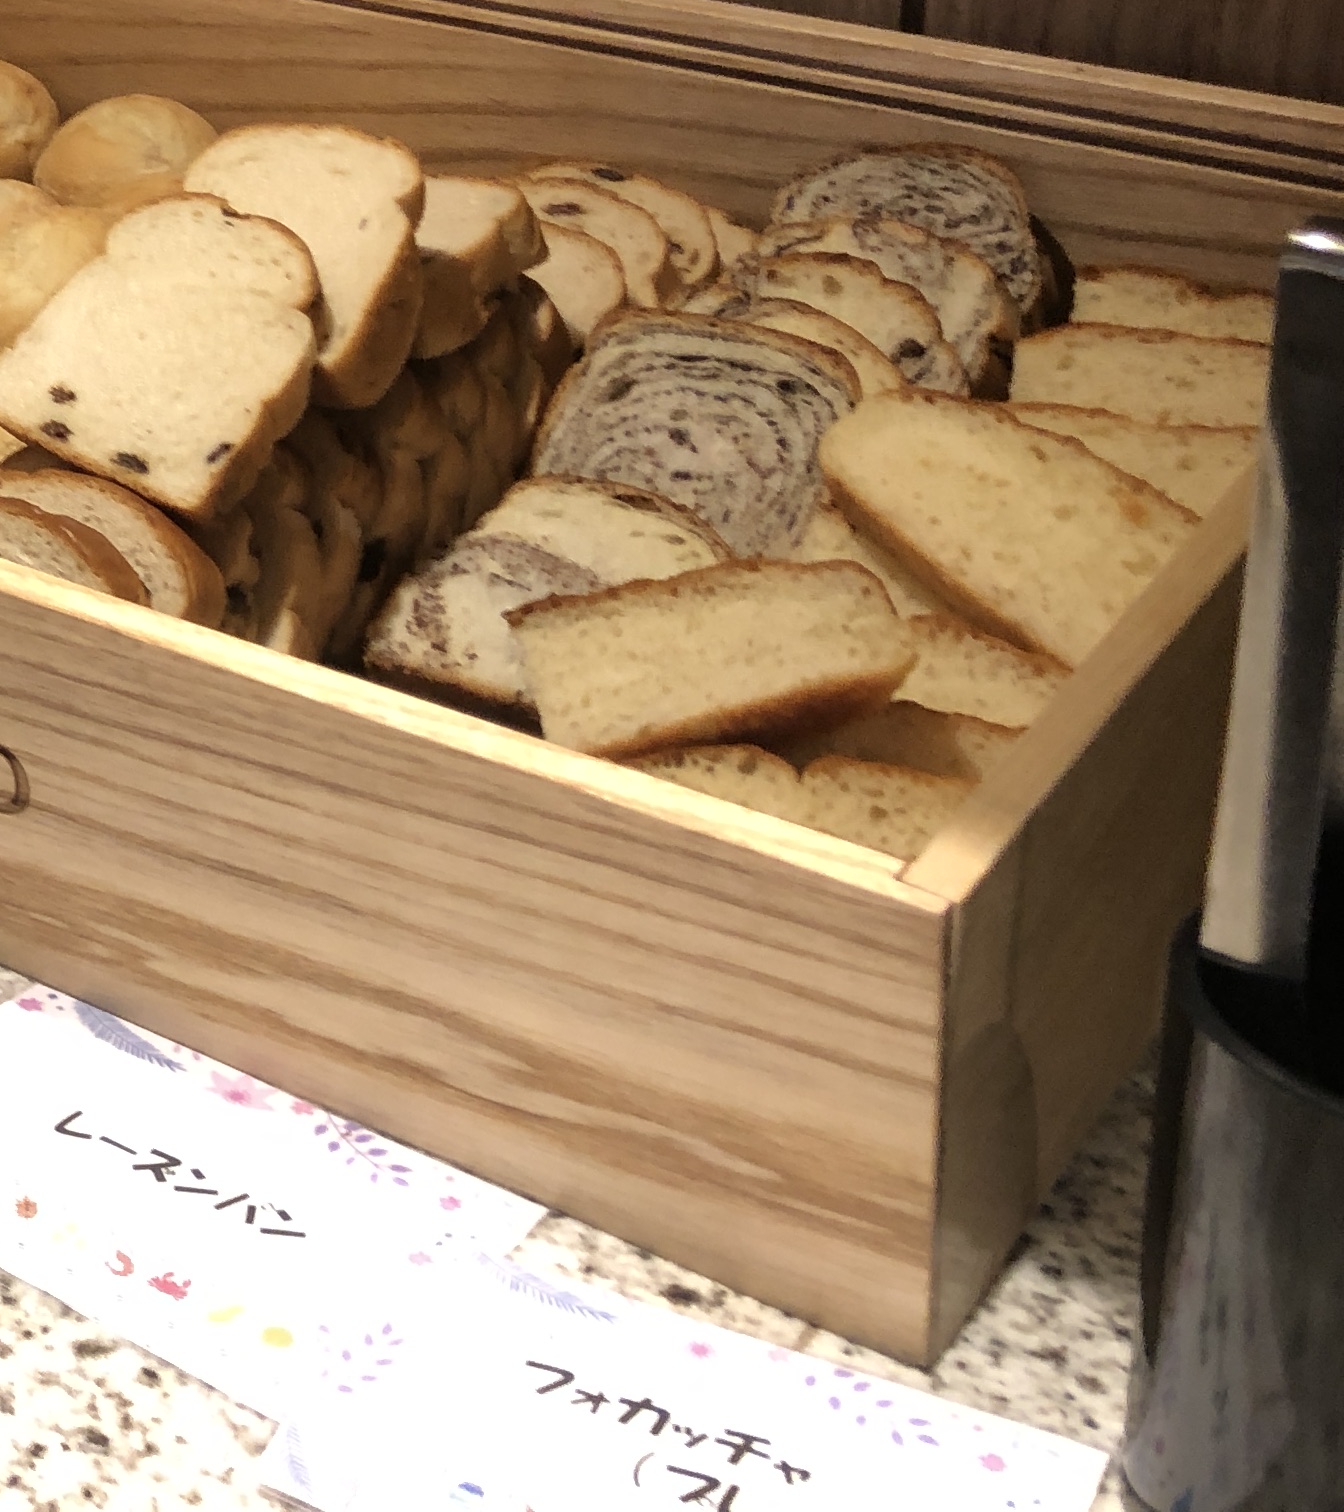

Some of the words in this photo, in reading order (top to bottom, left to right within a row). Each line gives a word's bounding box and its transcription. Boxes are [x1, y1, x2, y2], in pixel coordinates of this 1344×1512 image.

[525, 1359, 812, 1485] フォカッチャ
